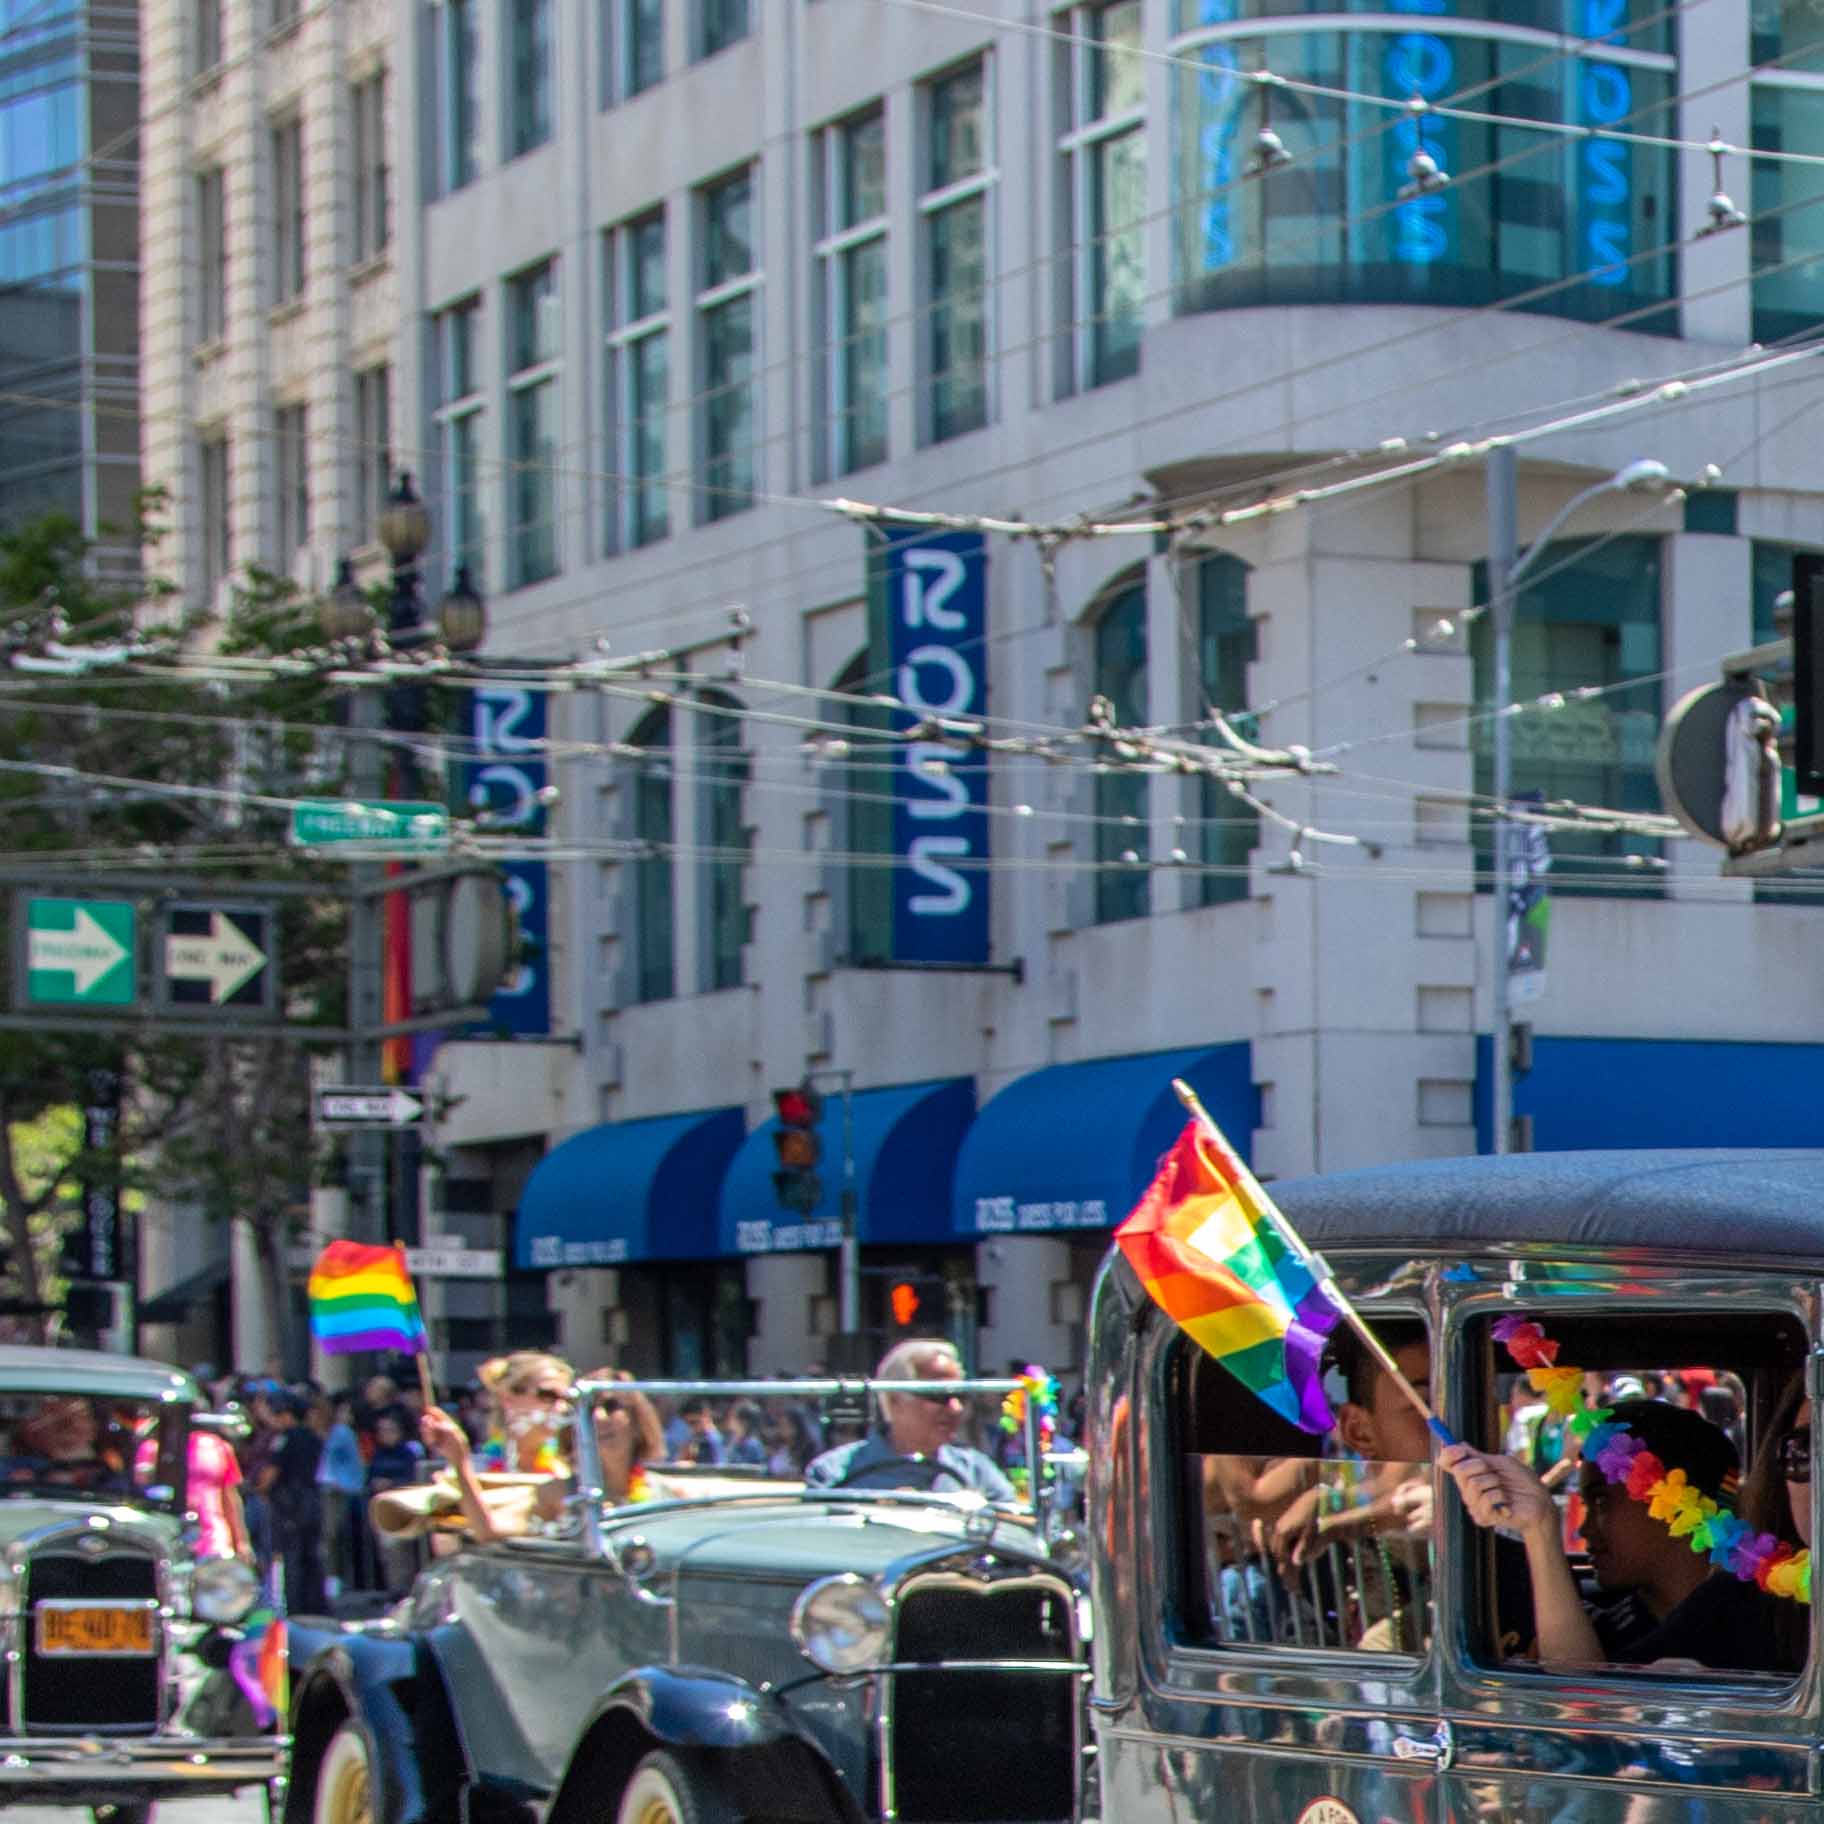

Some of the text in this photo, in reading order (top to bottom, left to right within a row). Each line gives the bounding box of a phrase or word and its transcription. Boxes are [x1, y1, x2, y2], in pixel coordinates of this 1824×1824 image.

[1386, 0, 1454, 263] OSS
[901, 548, 973, 914] ROSS
[1318, 1808, 1326, 1824] A
